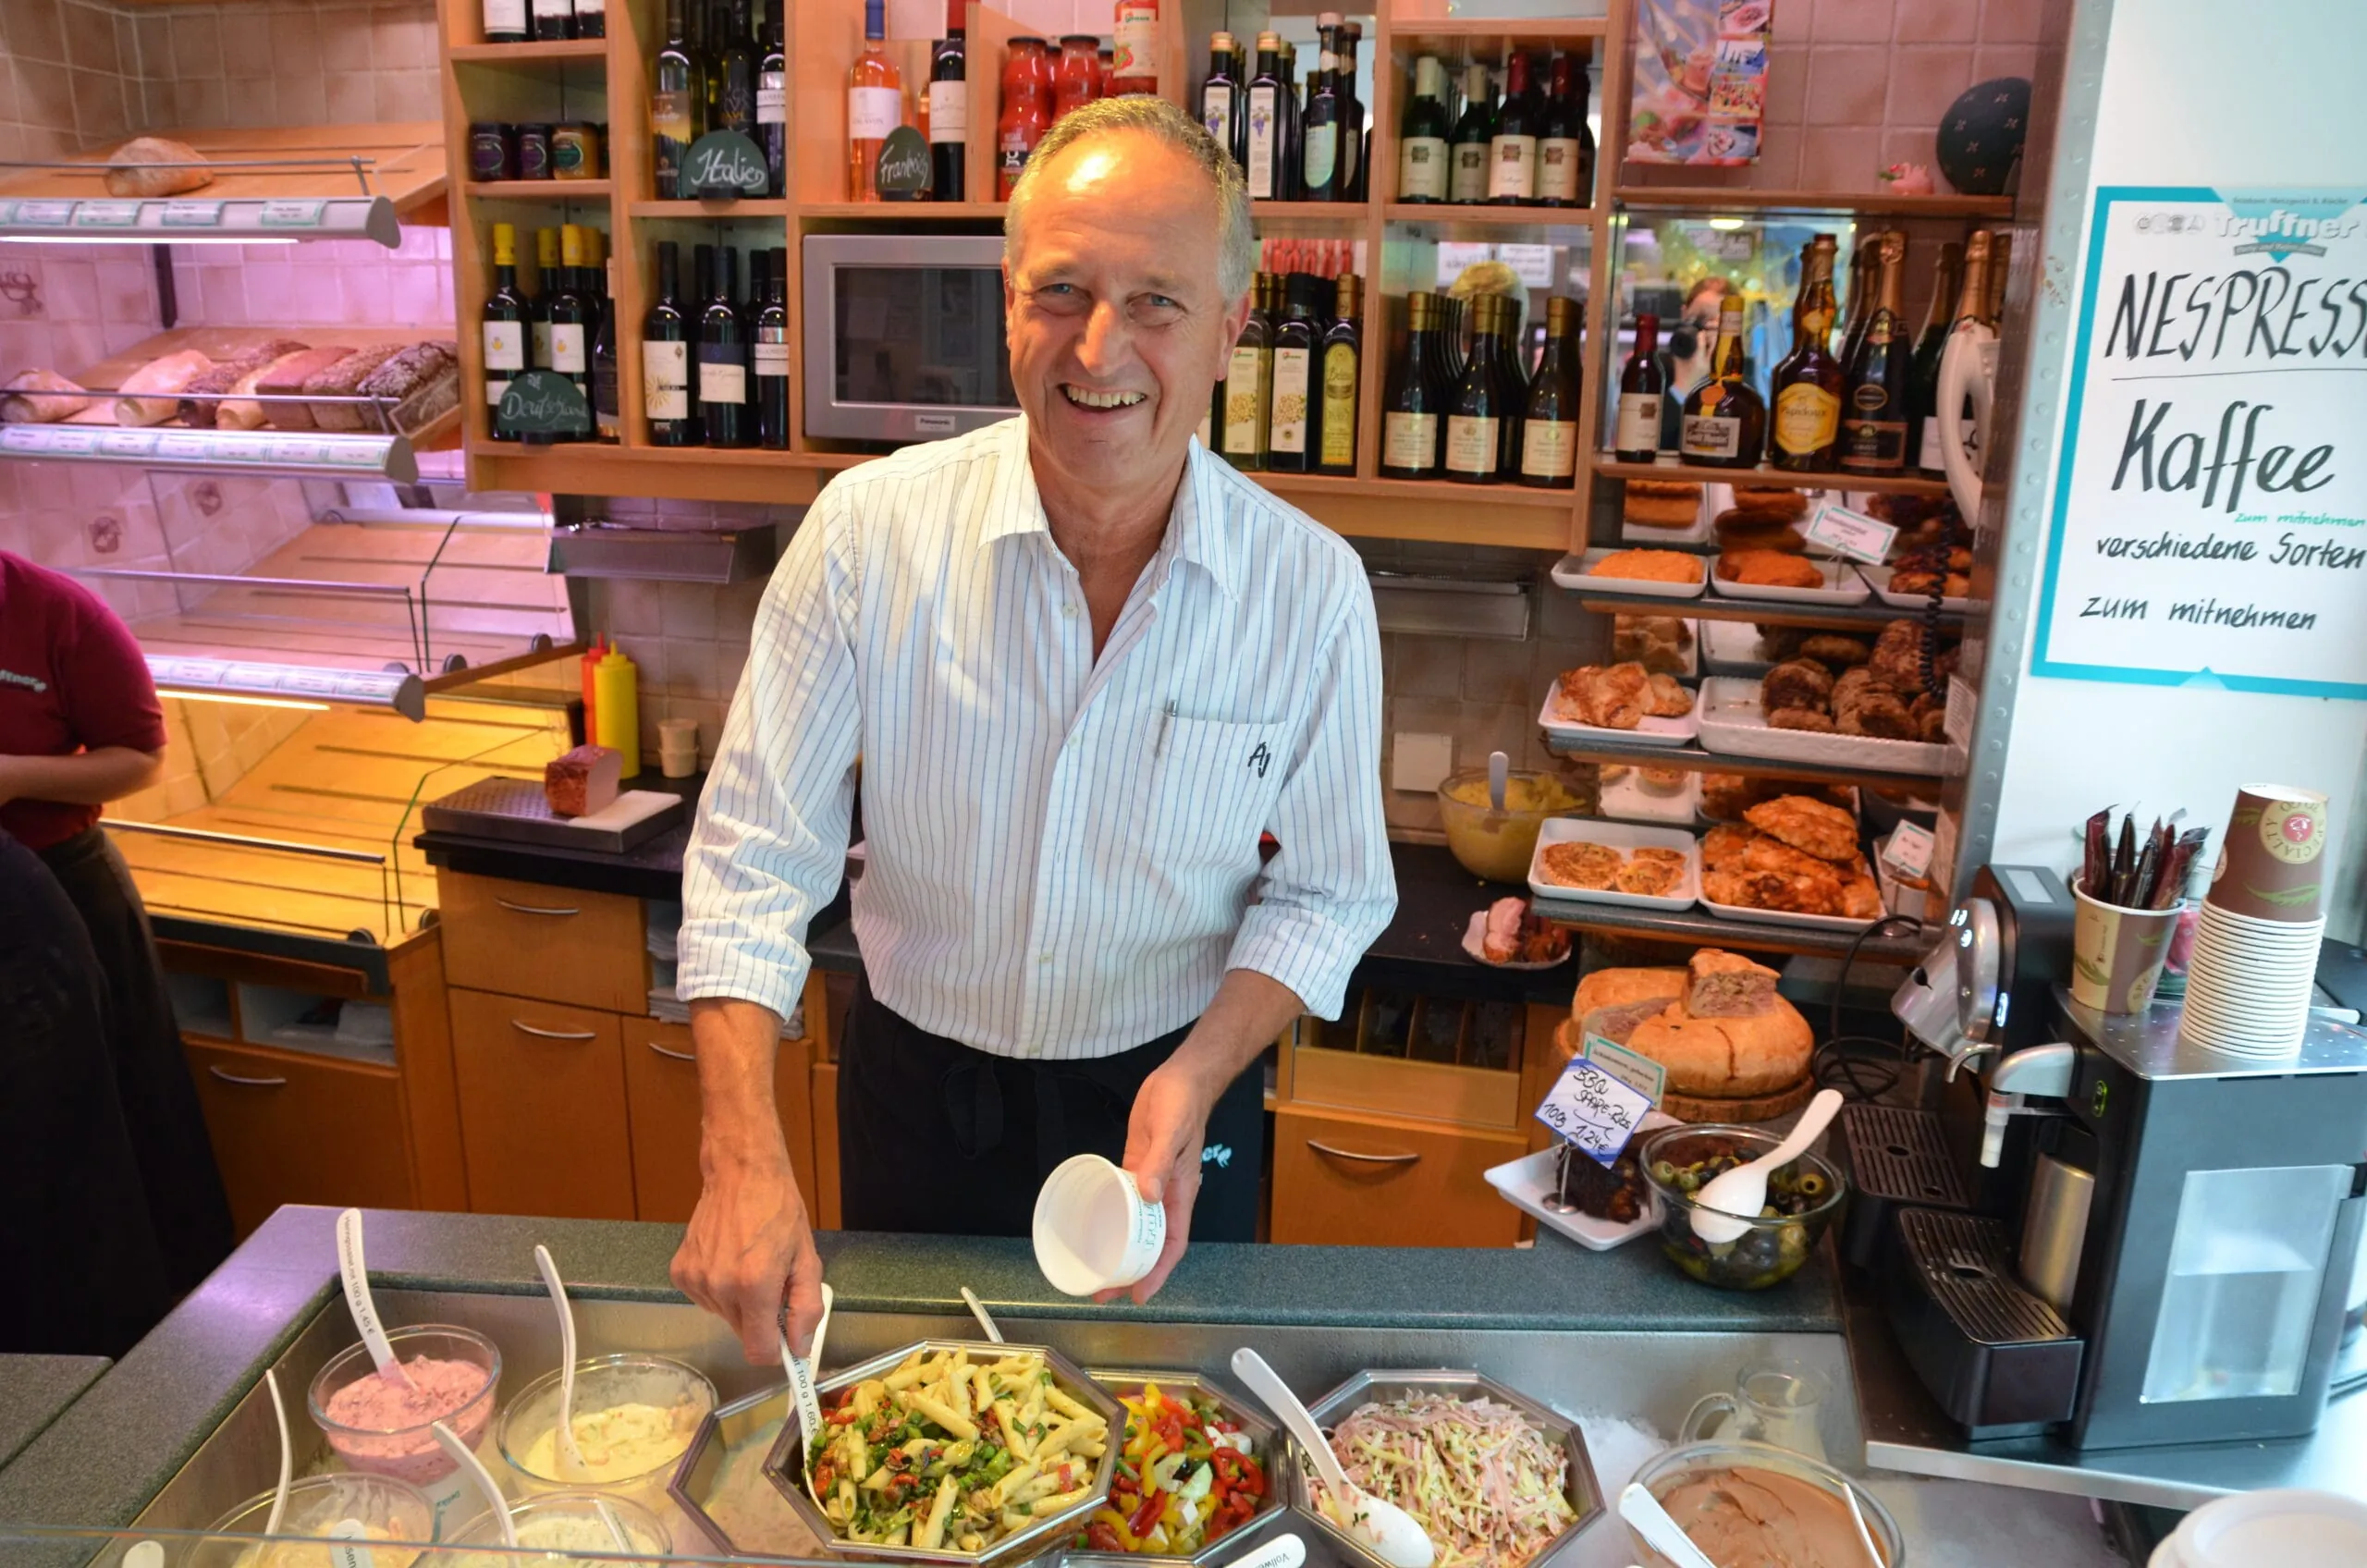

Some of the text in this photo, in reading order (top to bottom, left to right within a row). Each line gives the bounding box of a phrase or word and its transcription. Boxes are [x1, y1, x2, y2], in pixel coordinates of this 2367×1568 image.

[691, 147, 767, 190] Italien
[2215, 209, 2360, 239] Truffner
[2104, 266, 2367, 361] NESPRESS
[500, 391, 589, 425] Deutschland
[2111, 398, 2335, 513] Kaffee
[2234, 509, 2366, 527] zum mitnehmen
[2097, 533, 2366, 570] verschiedene Sorten
[2079, 595, 2318, 631] zum mitnehmen
[1573, 1065, 1609, 1095] BBQ
[351, 1281, 362, 1298] 100
[797, 1370, 808, 1389] 100
